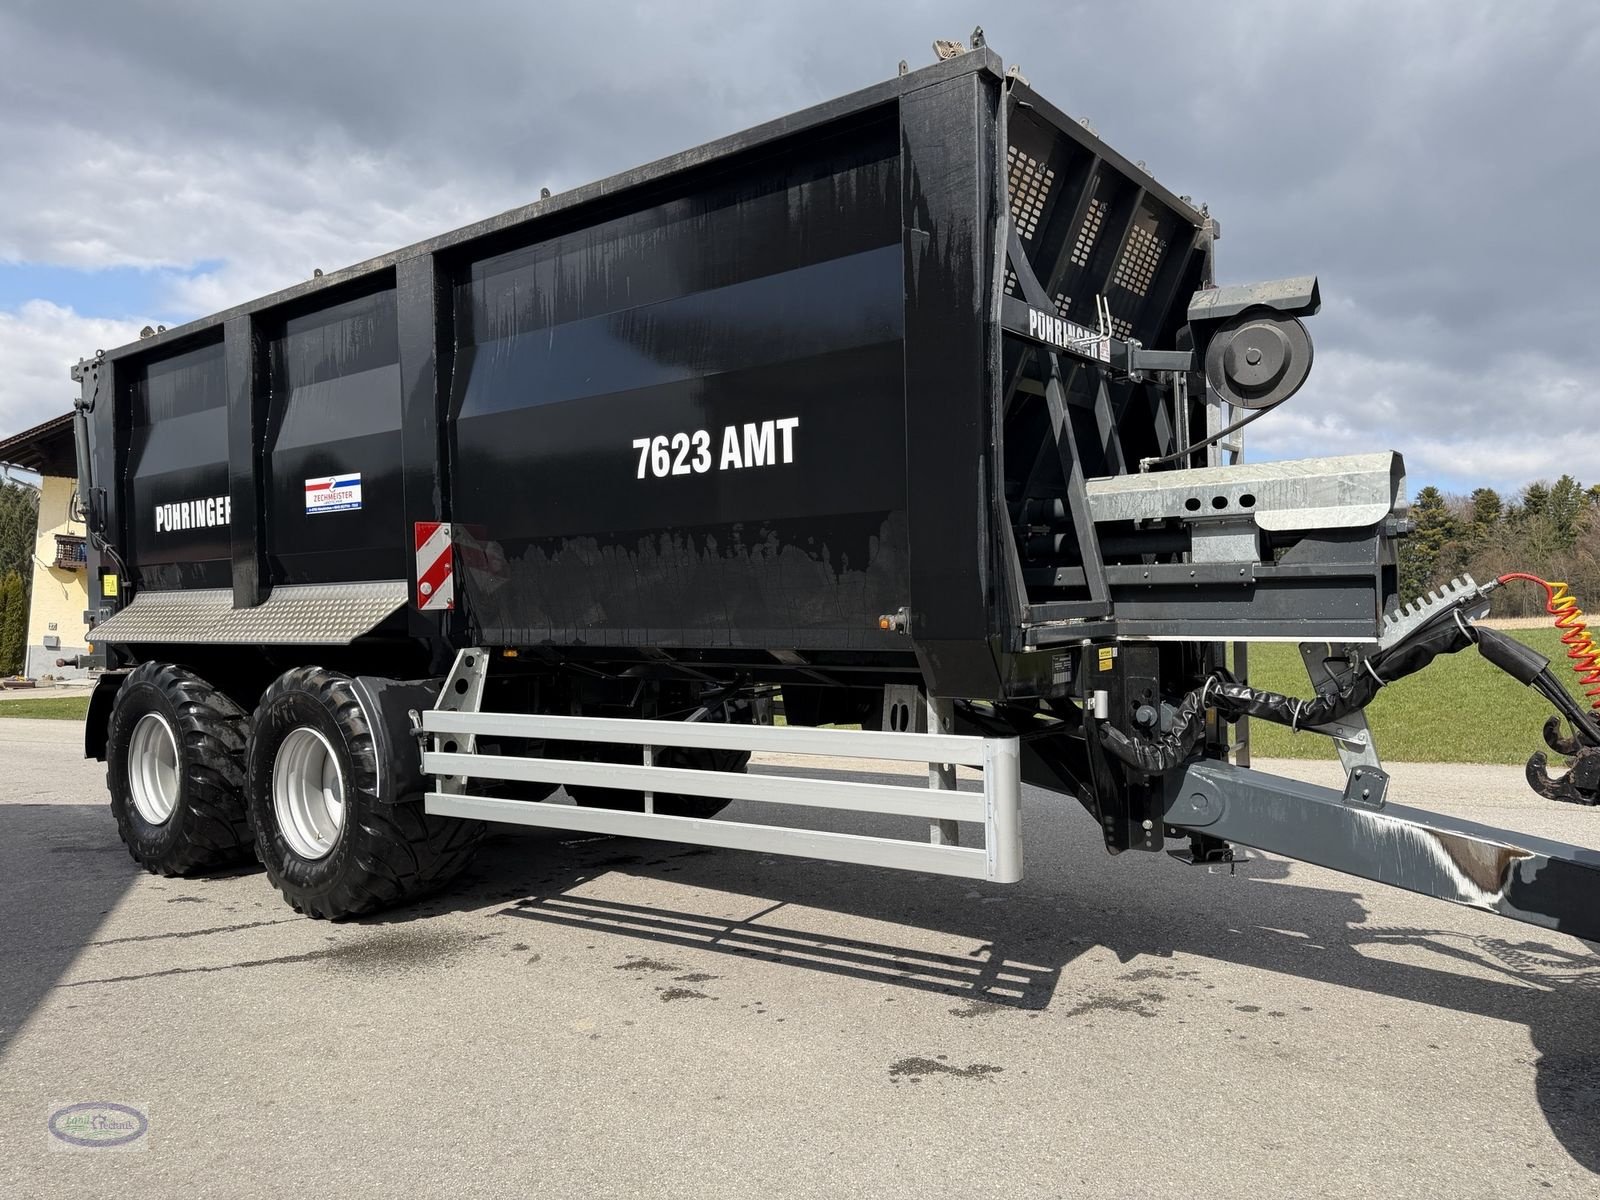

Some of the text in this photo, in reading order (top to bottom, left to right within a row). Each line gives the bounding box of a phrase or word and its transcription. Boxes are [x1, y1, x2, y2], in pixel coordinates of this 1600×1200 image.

[633, 417, 799, 479] 7623 AMT
[313, 491, 353, 502] ZECHMEISTER
